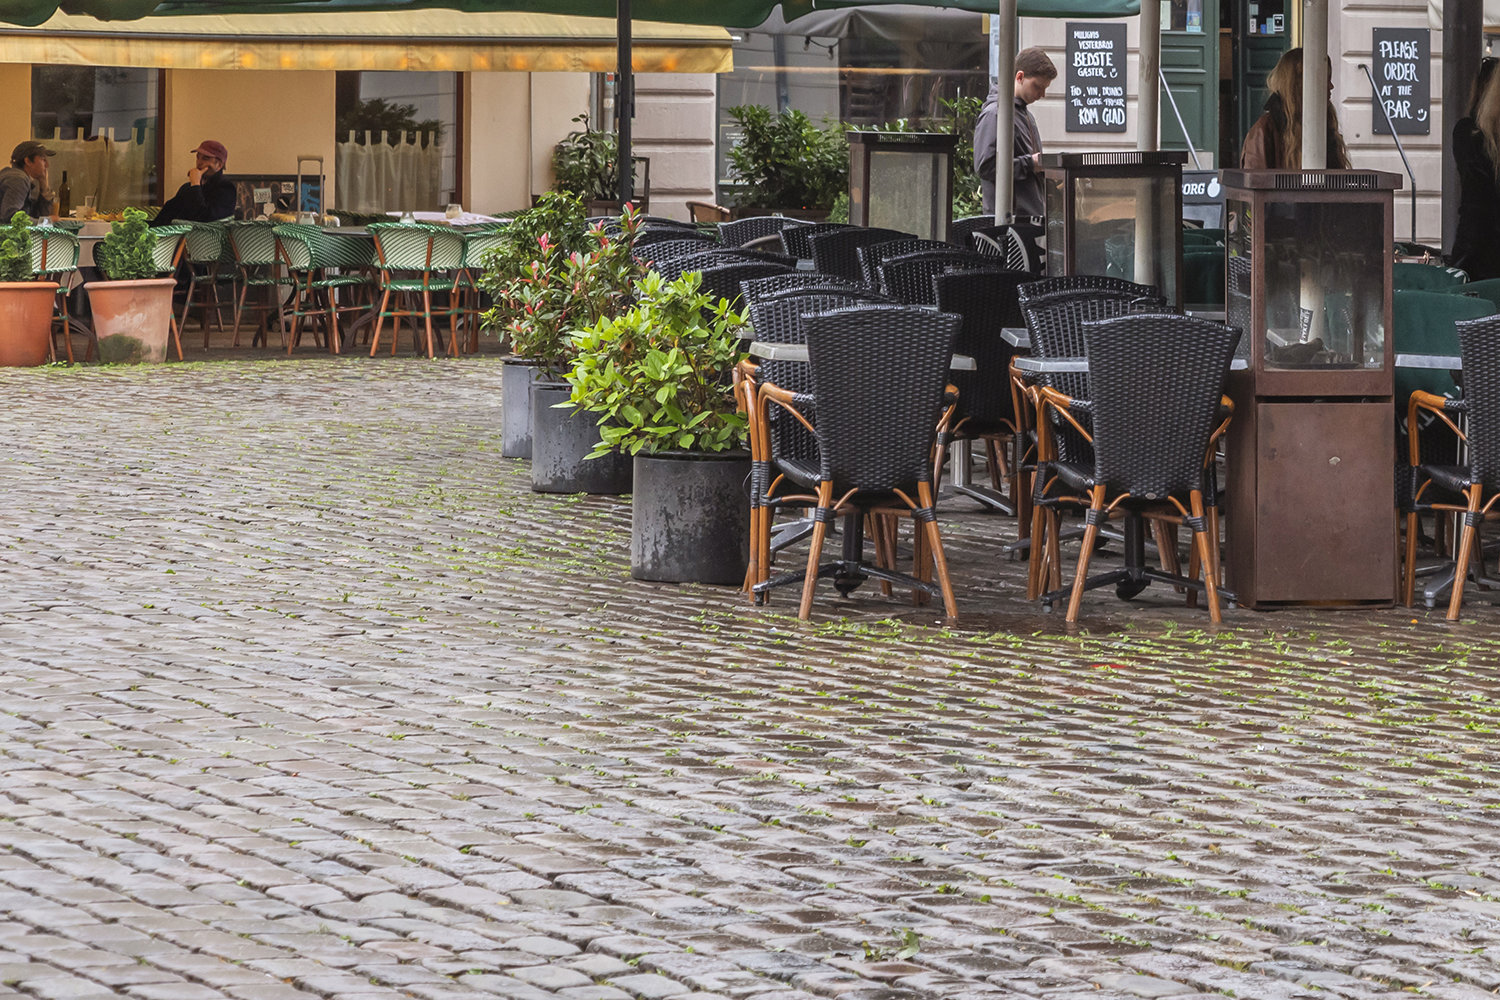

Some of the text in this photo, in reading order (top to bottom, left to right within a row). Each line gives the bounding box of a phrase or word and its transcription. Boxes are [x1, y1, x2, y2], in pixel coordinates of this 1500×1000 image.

[1379, 40, 1419, 60] PLEASE
[1073, 51, 1114, 67] BEDSTE
[1077, 67, 1107, 78] GÆSTER
[1383, 62, 1420, 82] ORDER
[1102, 86, 1123, 97] DRINKS
[1381, 85, 1412, 96] AT THE
[1071, 98, 1083, 107] TIL
[1086, 98, 1103, 106] GODE
[1384, 100, 1413, 119] BAR
[1078, 107, 1125, 126] KOM GLAD
[1182, 182, 1205, 195] ORG
